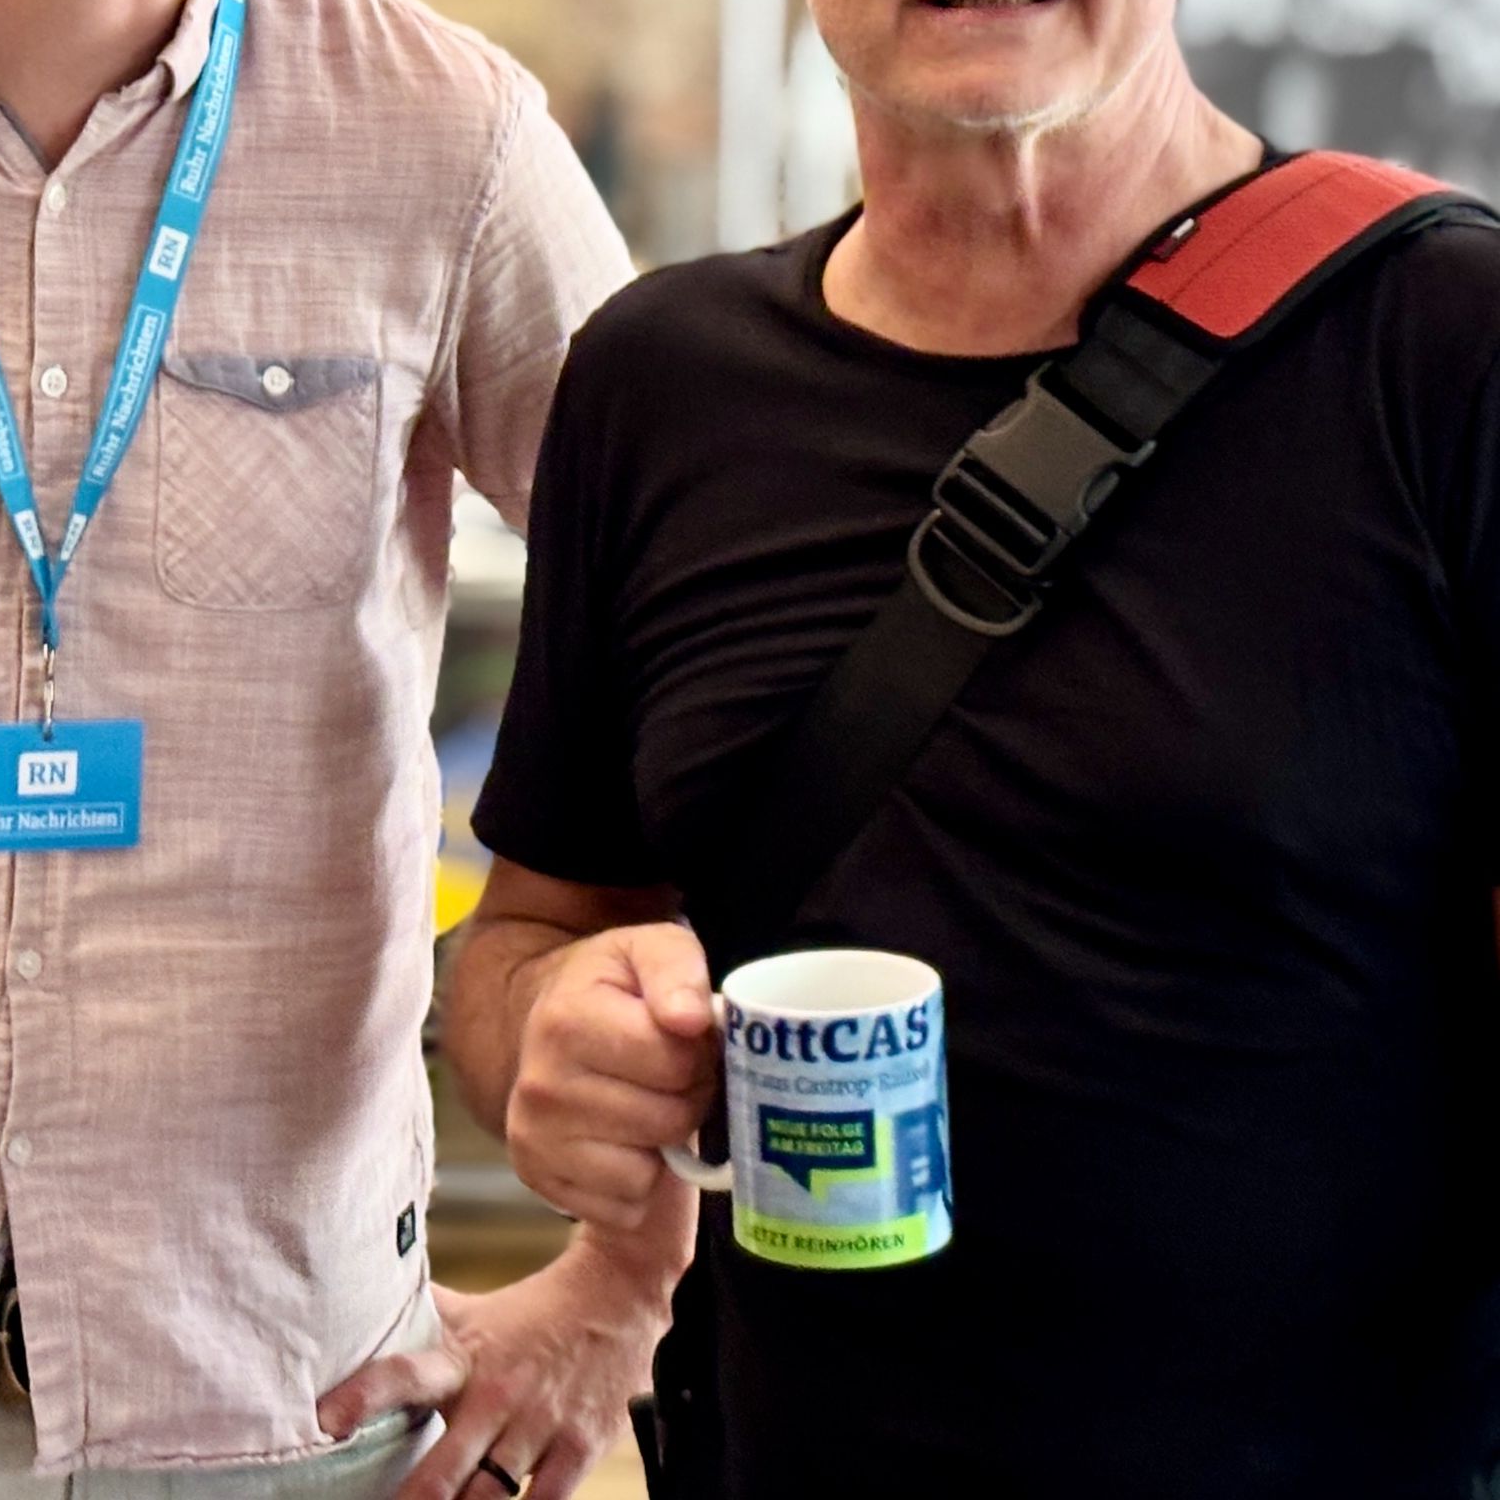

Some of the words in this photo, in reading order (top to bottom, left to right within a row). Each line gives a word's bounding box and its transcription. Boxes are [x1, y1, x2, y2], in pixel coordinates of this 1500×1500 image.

[179, 146, 208, 194] Ruhr
[195, 33, 234, 144] Nachrichten
[157, 233, 181, 270] RN
[91, 432, 121, 479] Ruhr
[110, 313, 159, 430] Nachrichten
[28, 761, 68, 786] RN
[18, 807, 119, 830] Nachrichten
